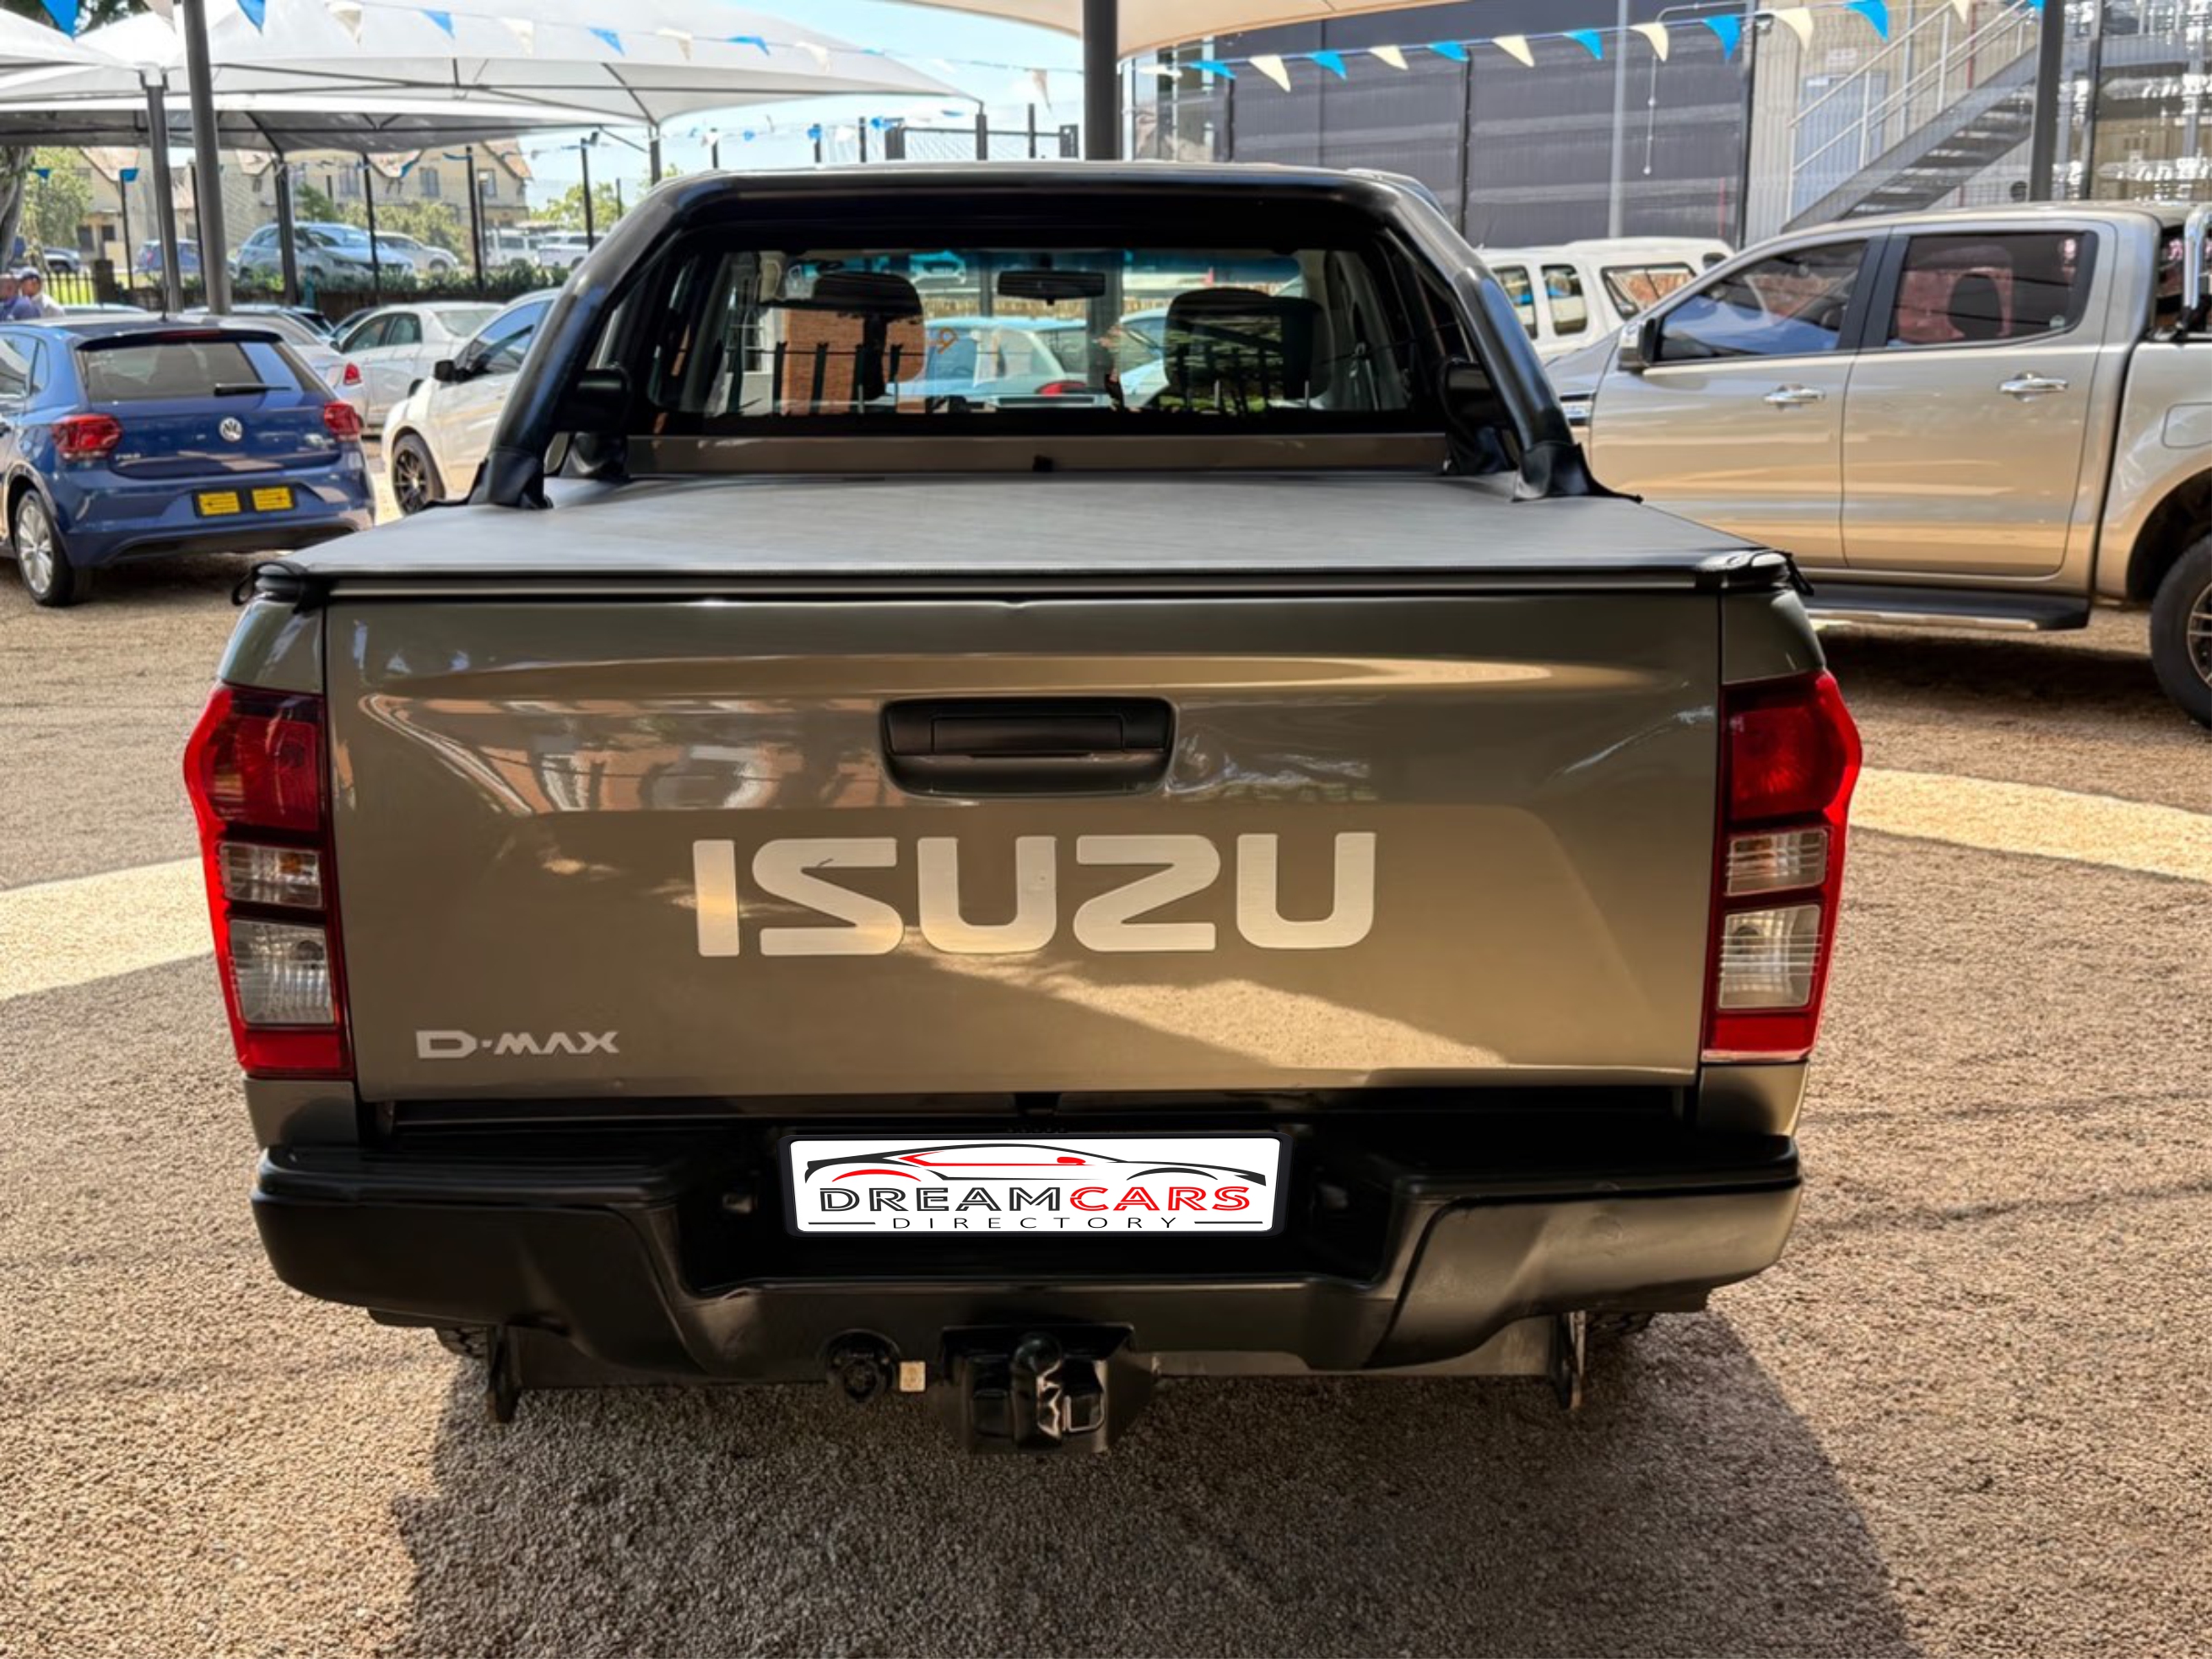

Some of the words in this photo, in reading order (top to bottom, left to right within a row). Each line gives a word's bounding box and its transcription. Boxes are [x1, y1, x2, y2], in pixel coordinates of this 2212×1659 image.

[693, 832, 1376, 957] ISUZU
[819, 1186, 1250, 1212] DREAMCARS
[892, 1217, 1178, 1229] DIRECTORY
